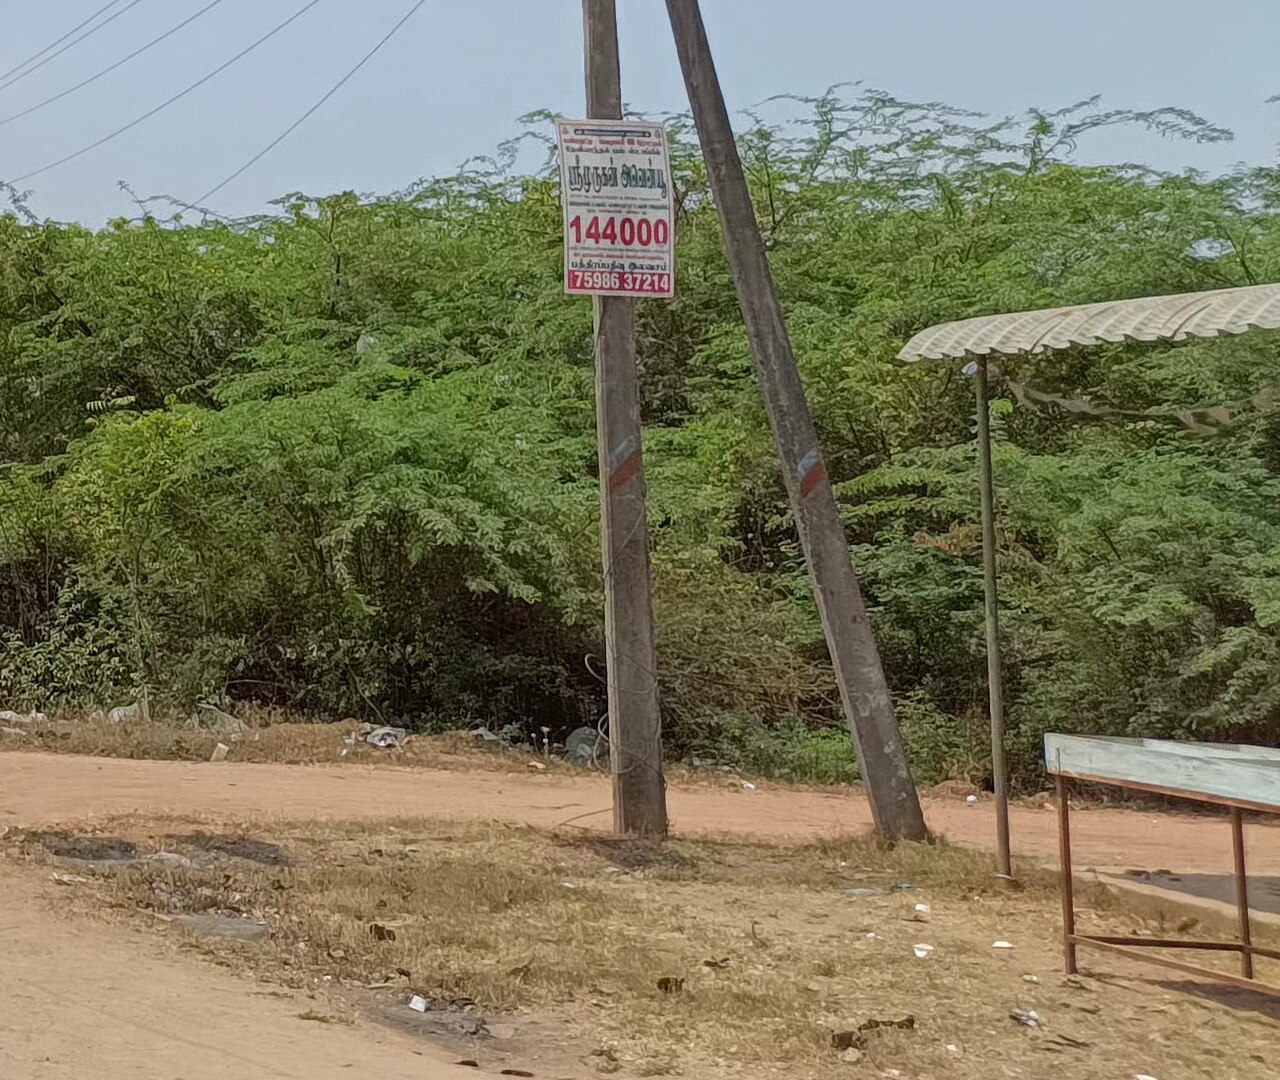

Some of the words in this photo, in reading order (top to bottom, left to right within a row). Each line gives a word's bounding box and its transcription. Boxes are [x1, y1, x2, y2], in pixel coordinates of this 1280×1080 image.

[569, 215, 668, 246] 144000
[574, 272, 620, 289] 75986
[624, 273, 669, 290] 37214
